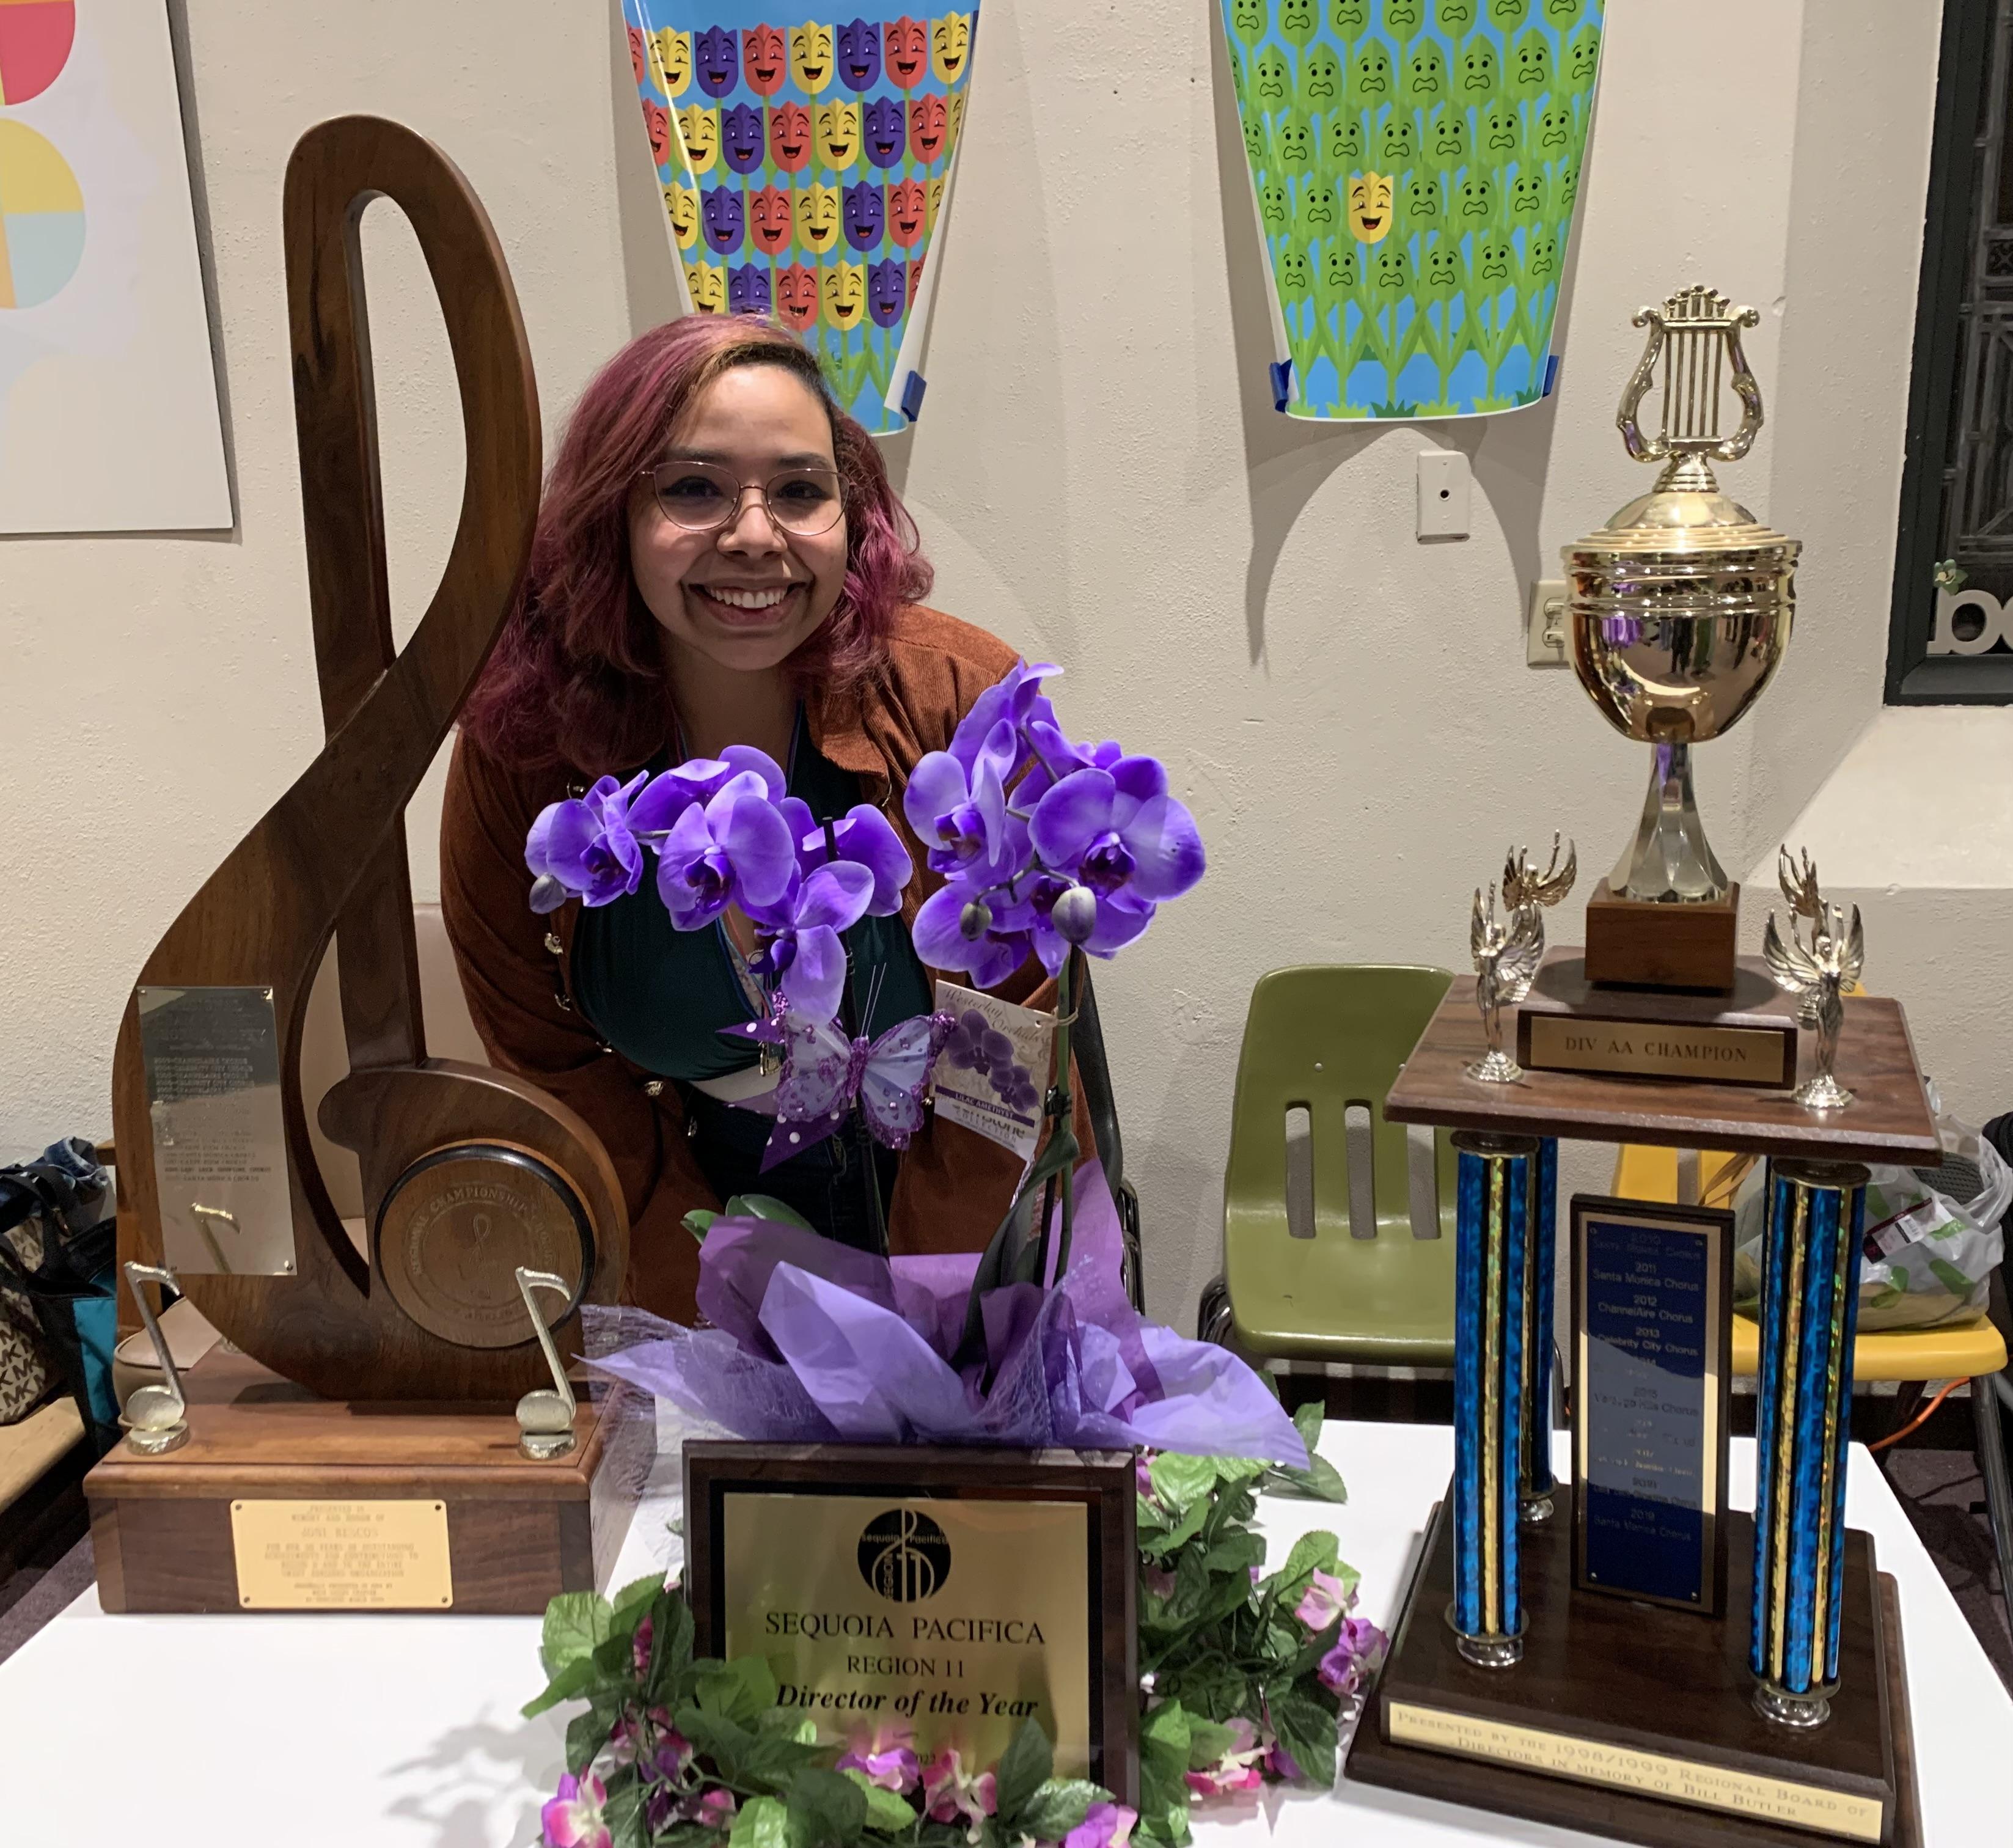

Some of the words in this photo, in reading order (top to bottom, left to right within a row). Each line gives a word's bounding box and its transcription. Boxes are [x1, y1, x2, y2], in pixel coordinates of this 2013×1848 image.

[1566, 1036, 1597, 1051] DIV
[1608, 1040, 1633, 1055] AA
[1645, 1042, 1747, 1062] CHAMPION
[1664, 1277, 1700, 1292] Chorus
[1632, 1294, 1658, 1307] 2012
[1659, 1310, 1694, 1324] Chorus
[1642, 1340, 1662, 1352] City
[1664, 1343, 1699, 1357] Chorus
[765, 1612, 895, 1641] SEQUOIA
[912, 1616, 1046, 1646] PACIFICA
[846, 1655, 936, 1677] REGION
[945, 1659, 964, 1679] 11
[776, 1684, 887, 1710] Director
[893, 1689, 925, 1718] of
[929, 1690, 970, 1715] the
[978, 1692, 1039, 1717] Year
[1398, 1712, 1482, 1737] PRESENTED
[1491, 1733, 1509, 1744] BY
[1519, 1738, 1547, 1751] THE
[1555, 1744, 1669, 1776] 1998/1999
[1679, 1767, 1767, 1797] REGIONAL
[1776, 1788, 1838, 1811] BOARD
[1847, 1805, 1870, 1818] OF
[1457, 1736, 1544, 1766] DIRECTORS
[1552, 1758, 1569, 1769] IN
[1577, 1764, 1645, 1784] MEMORY
[1654, 1780, 1674, 1791] OF
[1684, 1783, 1723, 1802] BILL
[1733, 1793, 1797, 1817] BUTLER
